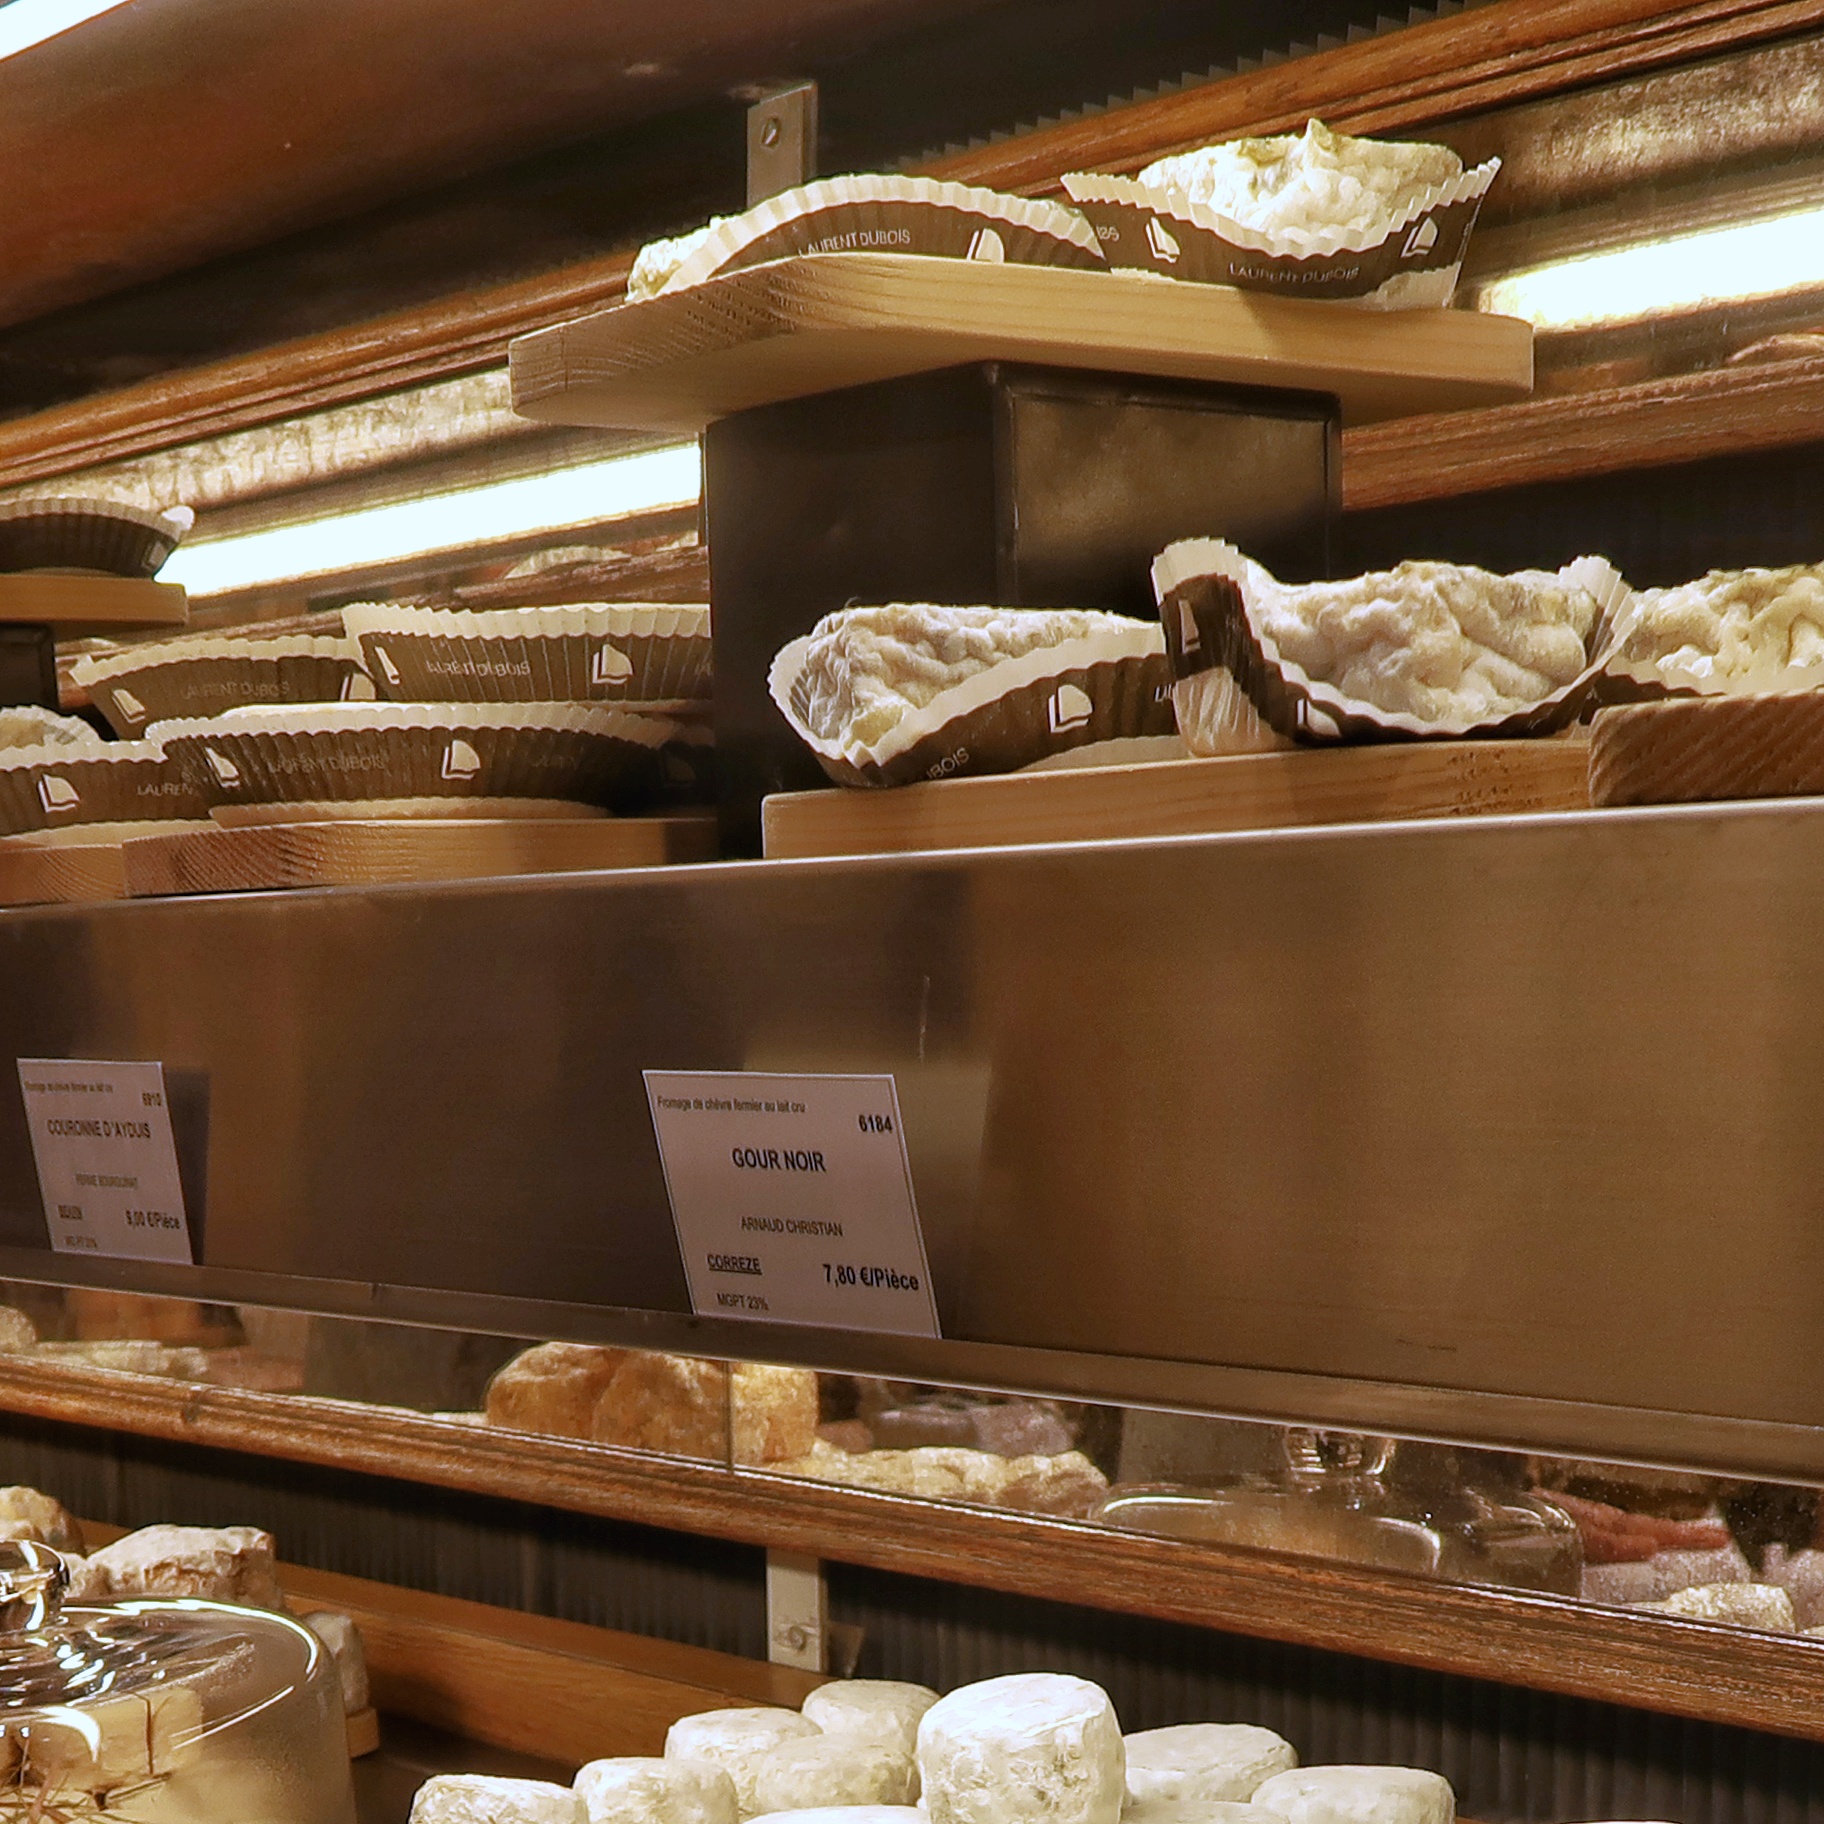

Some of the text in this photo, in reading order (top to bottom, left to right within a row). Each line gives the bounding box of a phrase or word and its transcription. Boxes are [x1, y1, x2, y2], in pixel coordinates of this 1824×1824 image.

[798, 228, 911, 258] LAURENT DUBOIS
[926, 747, 971, 780] BOIS
[858, 1114, 893, 1133] 6184
[732, 1147, 826, 1172] GOUR NOIR
[740, 1216, 844, 1238] ARNAUD CHRISTIAN
[707, 1254, 762, 1275] CORREZE
[823, 1263, 920, 1292] 7,80 €/Pièce
